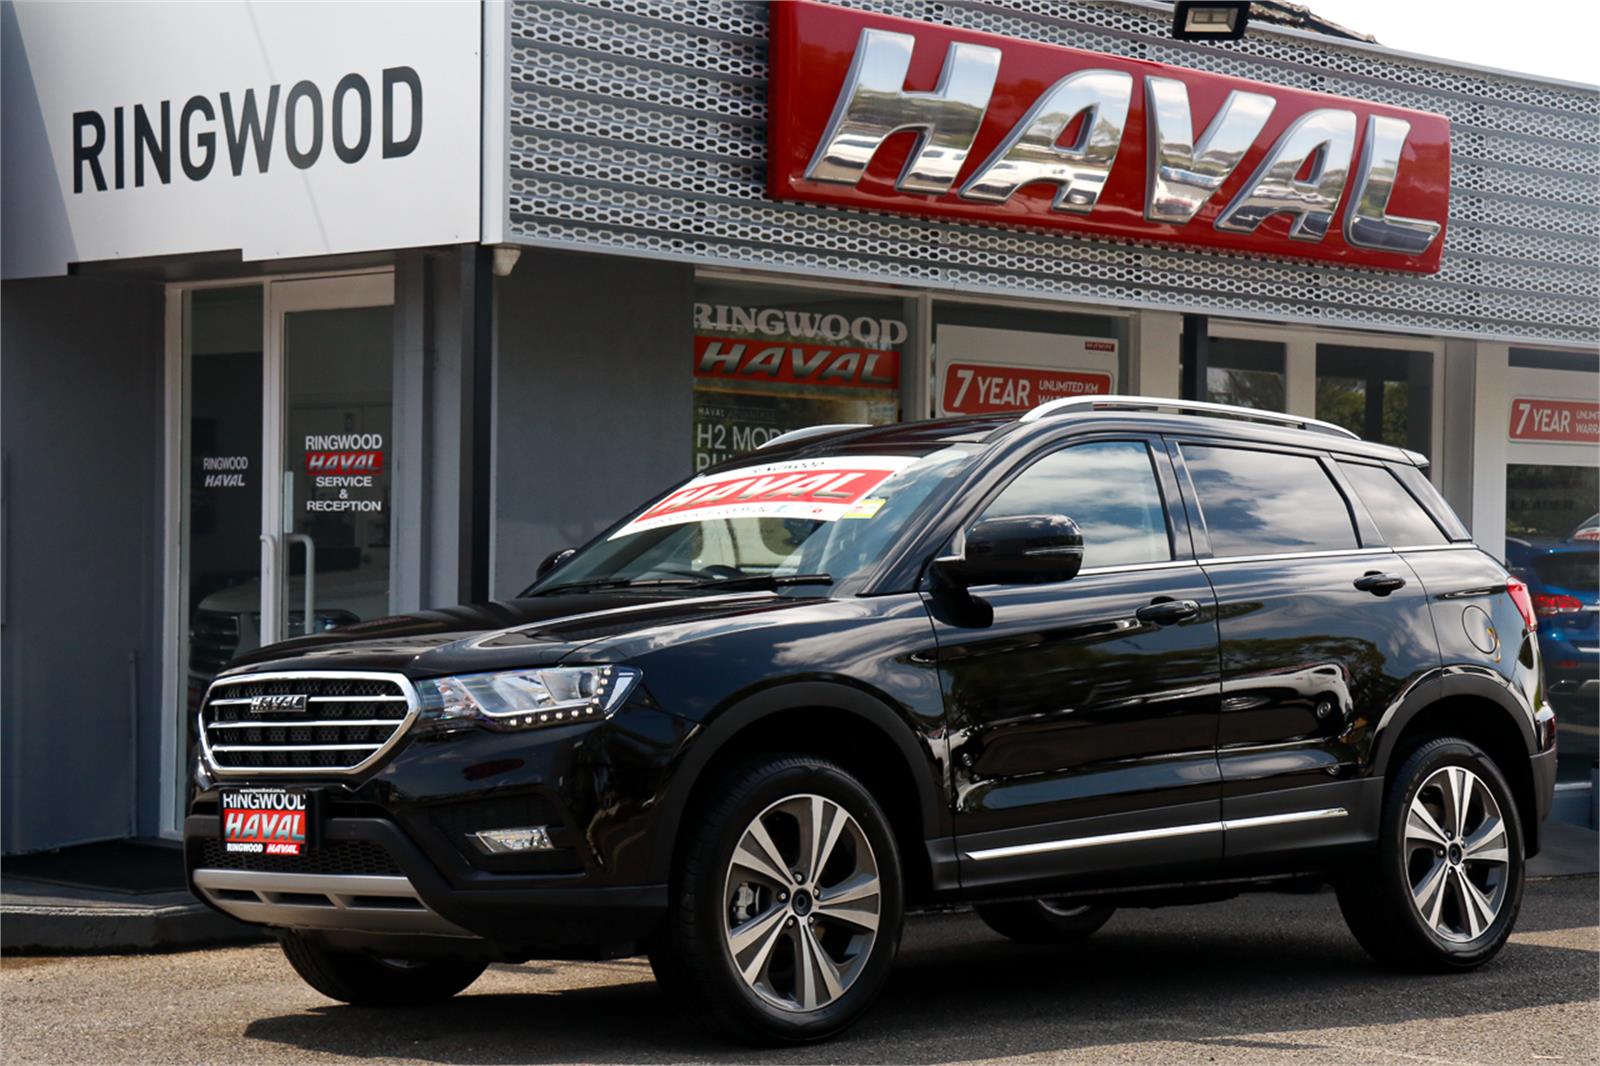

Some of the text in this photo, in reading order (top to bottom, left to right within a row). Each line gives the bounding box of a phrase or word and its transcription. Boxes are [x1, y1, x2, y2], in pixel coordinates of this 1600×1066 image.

[73, 66, 423, 194] RINGWOOD
[804, 28, 1440, 255] HAVAL
[693, 303, 908, 346] RINGWOOD
[698, 340, 894, 384] HAVAL
[953, 369, 1031, 408] 7 YEAR
[1039, 380, 1099, 394] UNLIMITED KM
[1515, 403, 1571, 435] 7 YEAR
[305, 434, 382, 451] RINGWOOD
[697, 423, 727, 450] H2
[203, 456, 248, 471] RINGWOOD
[308, 453, 380, 471] HAVAL
[204, 474, 246, 488] HAVAL
[316, 476, 372, 488] SERVICE
[338, 488, 348, 499] &
[648, 472, 866, 516] HAVAL
[306, 500, 382, 512] RECEPTION
[225, 812, 305, 841] HAVAL
[227, 843, 299, 854] RINGWOOD HAVAL
